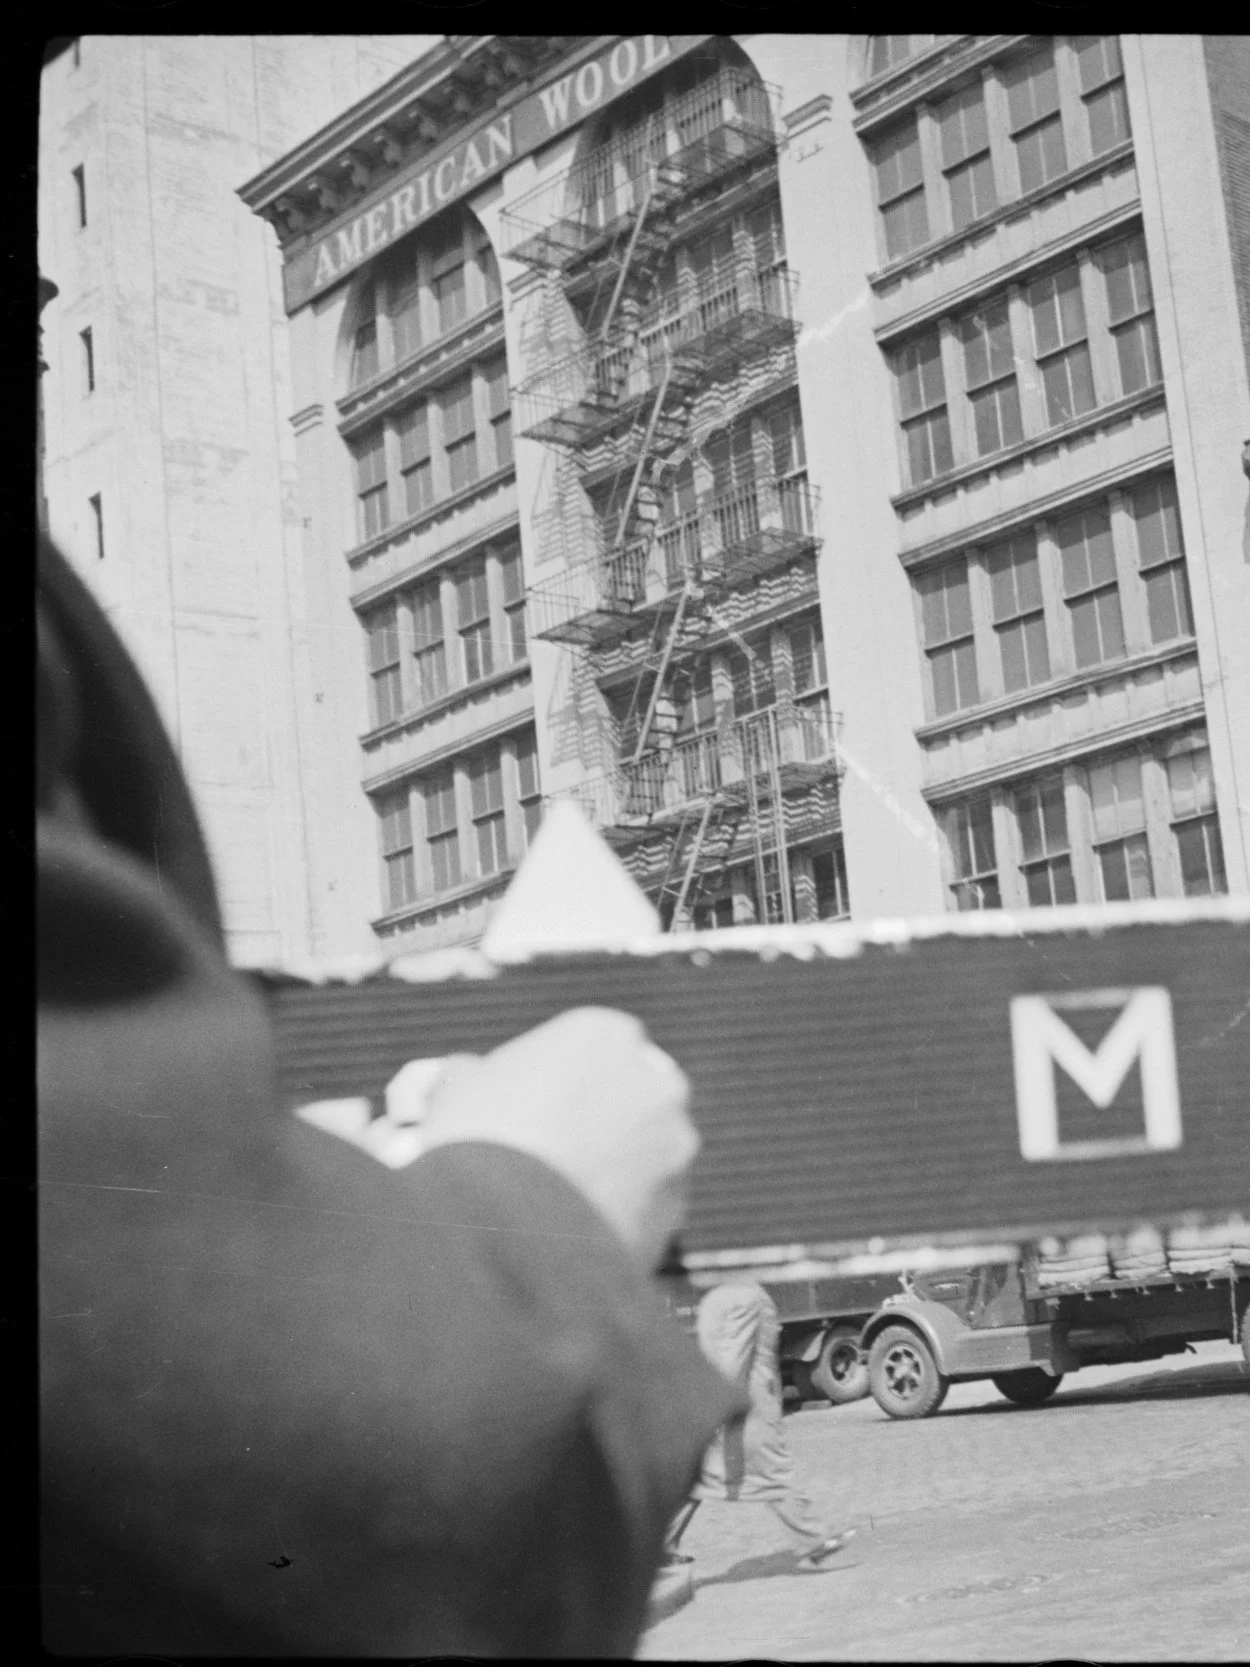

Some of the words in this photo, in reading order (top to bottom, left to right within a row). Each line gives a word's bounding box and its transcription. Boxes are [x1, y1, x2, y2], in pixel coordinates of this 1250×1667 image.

[313, 114, 513, 287] AMERICAN
[538, 35, 669, 131] WOOL
[1010, 985, 1183, 1163] M
